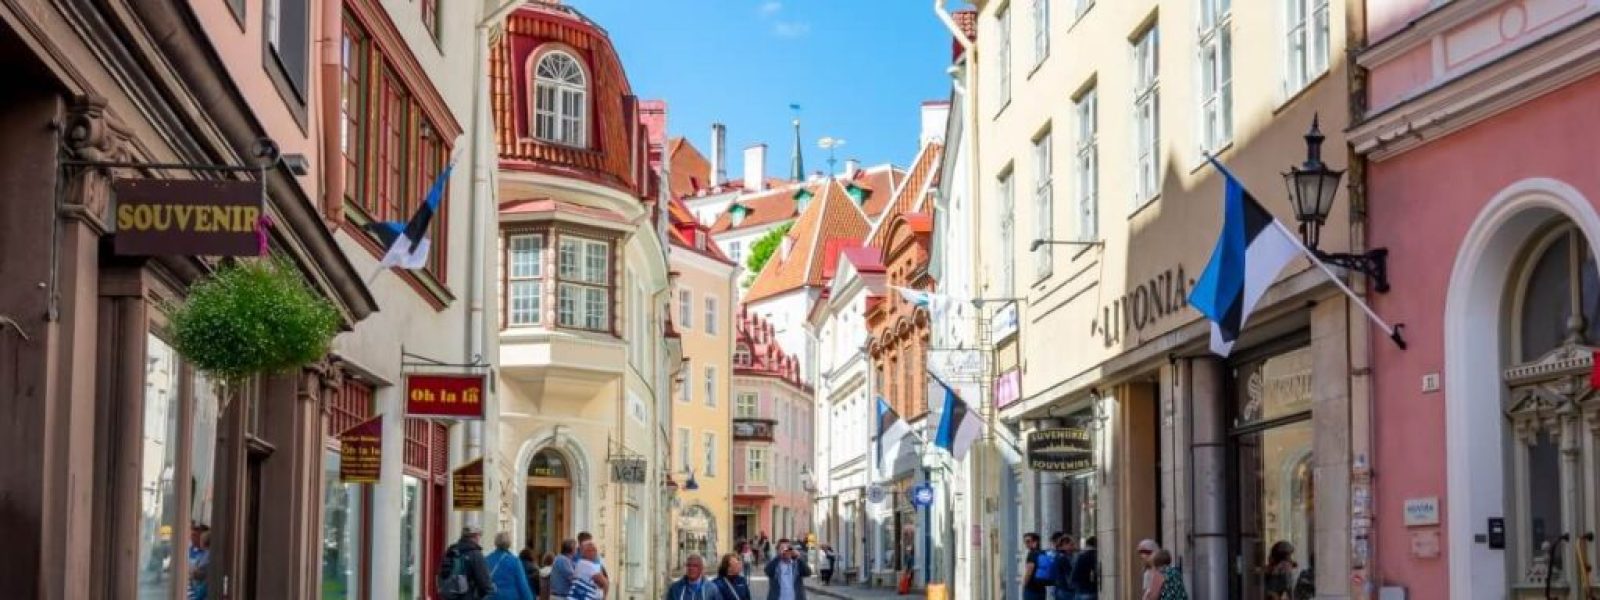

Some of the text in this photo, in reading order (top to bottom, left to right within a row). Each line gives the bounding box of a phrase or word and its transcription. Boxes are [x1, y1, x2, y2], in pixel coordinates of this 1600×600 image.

[117, 203, 260, 233] SOUVENIR
[1103, 263, 1187, 347] LIVONIA
[411, 388, 434, 403] Oh
[440, 388, 457, 403] la
[1032, 459, 1090, 470] SOUVENIRS
